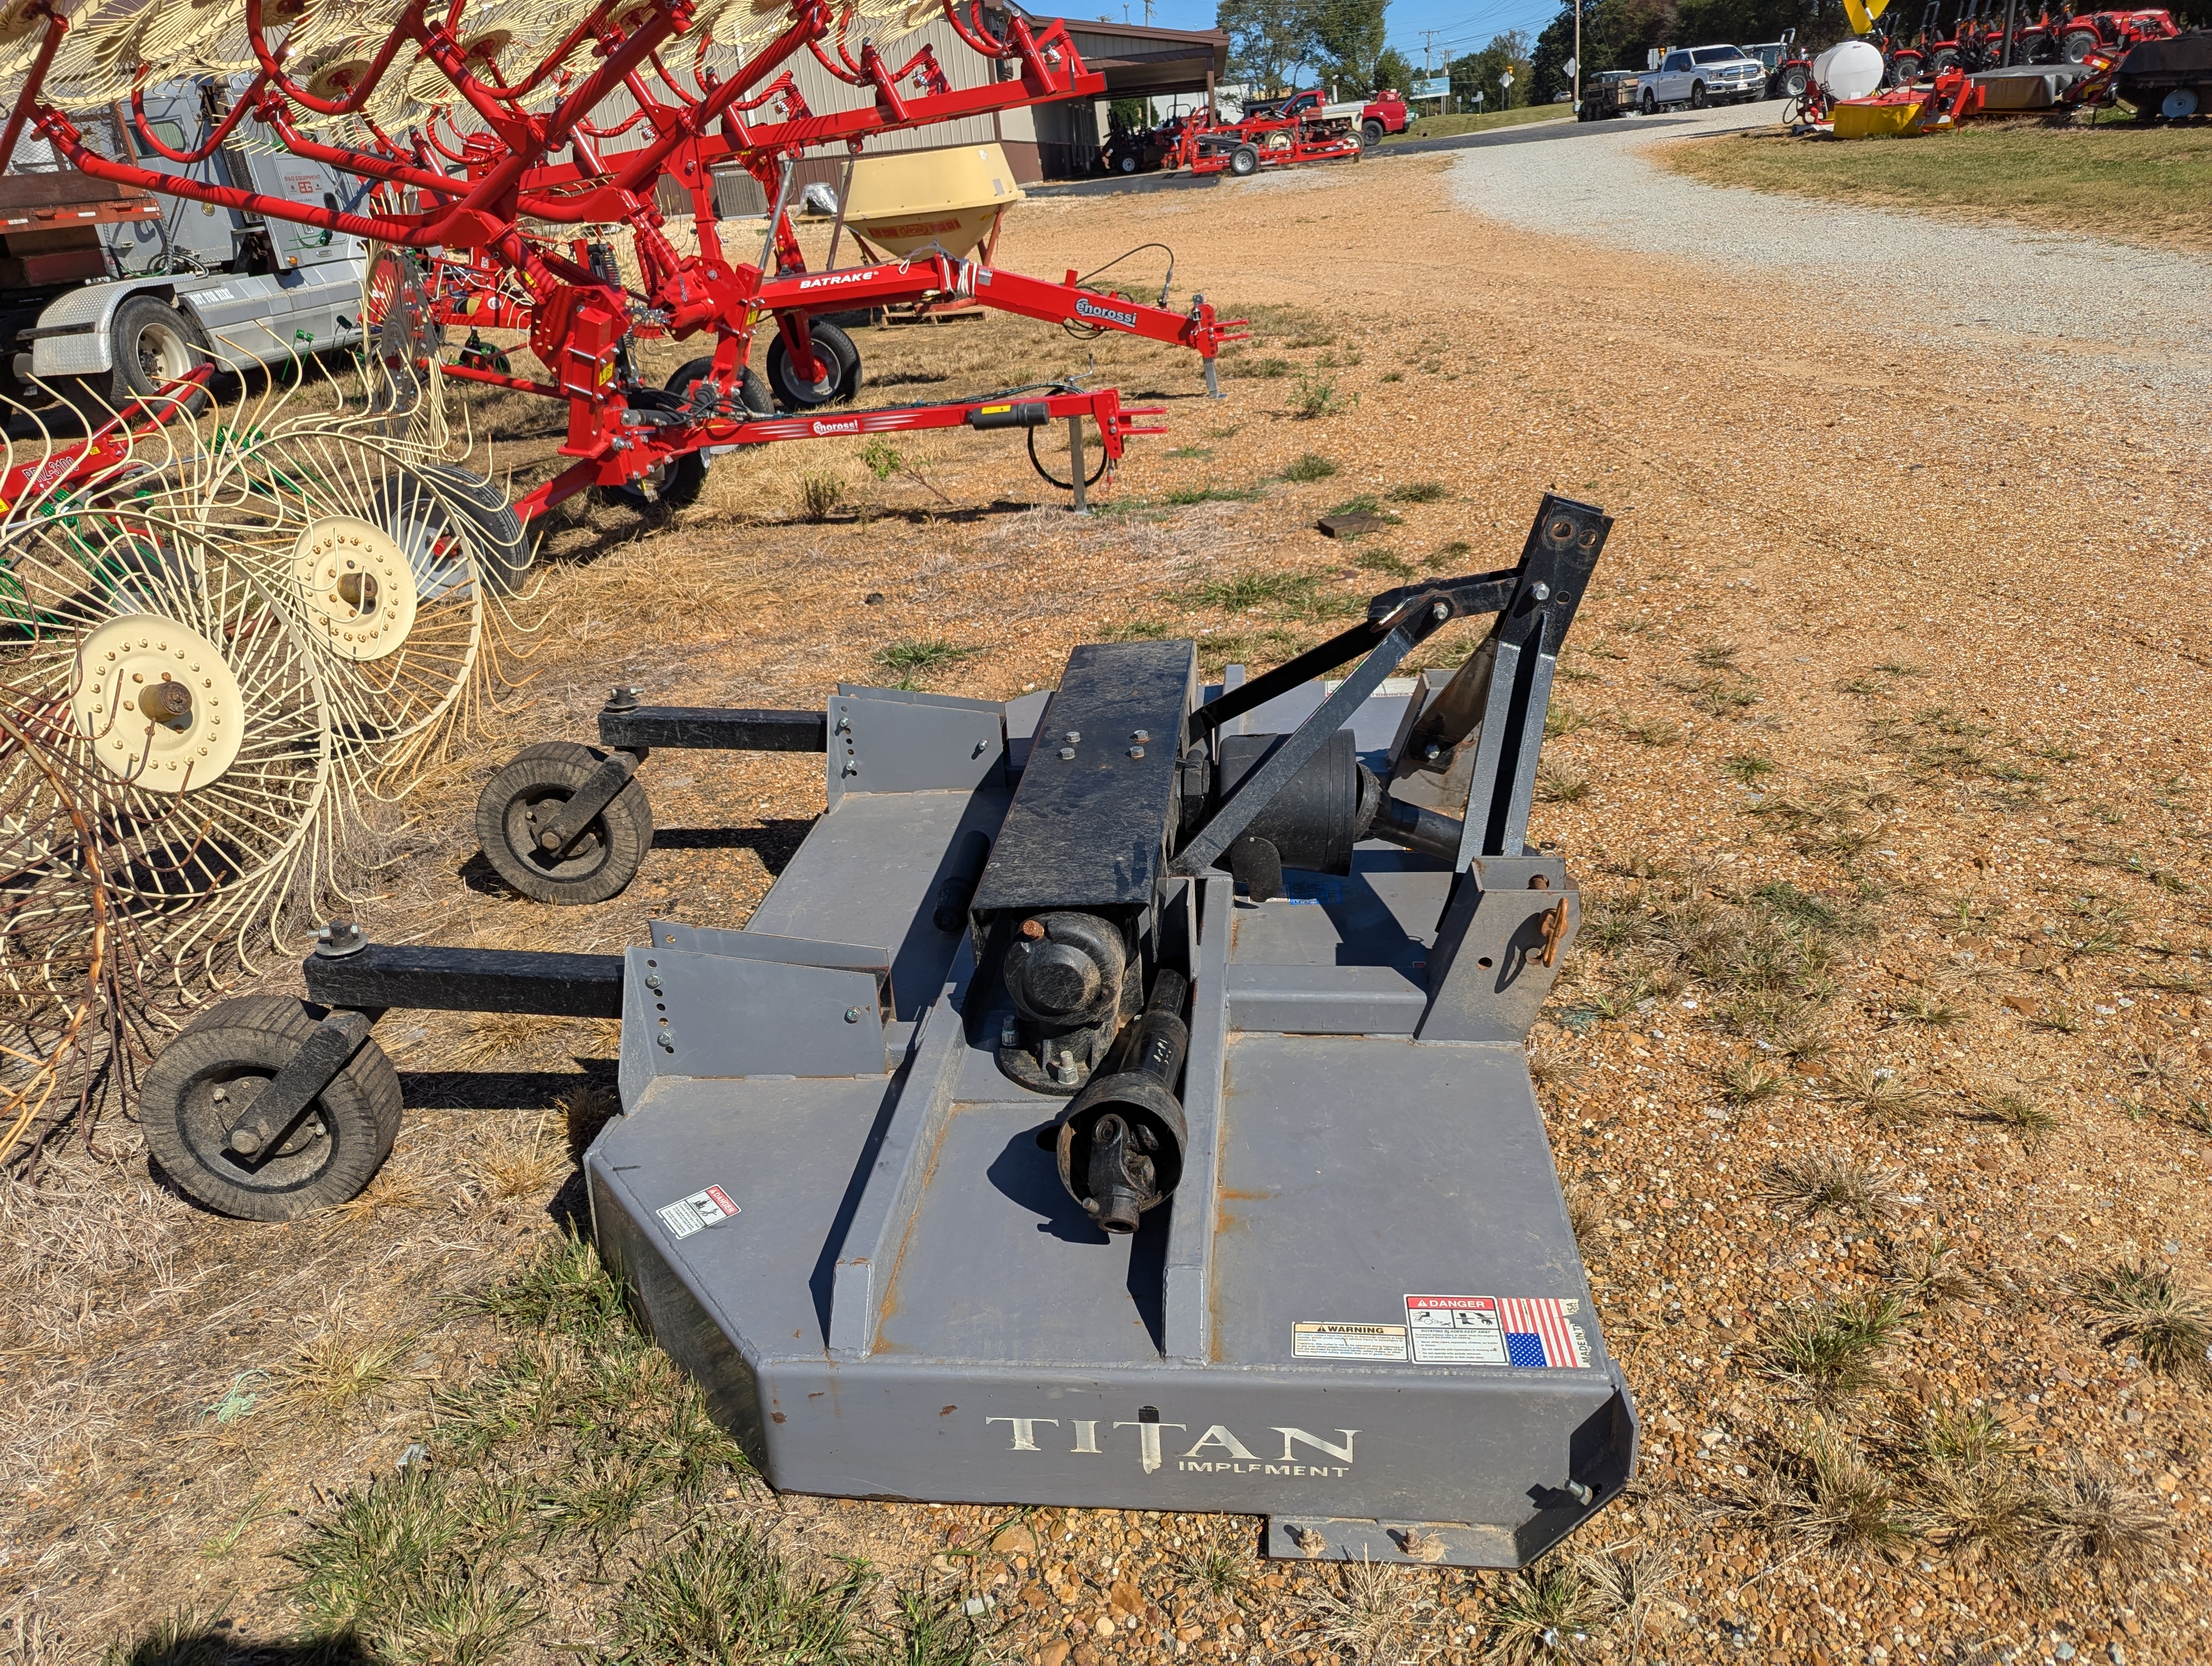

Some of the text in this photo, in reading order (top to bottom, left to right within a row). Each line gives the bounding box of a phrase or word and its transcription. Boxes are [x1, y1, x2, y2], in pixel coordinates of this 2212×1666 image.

[800, 271, 873, 289] BATRAKE
[188, 288, 235, 305] NOT FOR HIRE
[713, 1192, 735, 1213] DANGER
[1429, 1300, 1485, 1308] DANGER
[1328, 1326, 1384, 1334] WARNING
[1577, 1341, 1591, 1363] MADE
[986, 1415, 1365, 1474] TITAN
